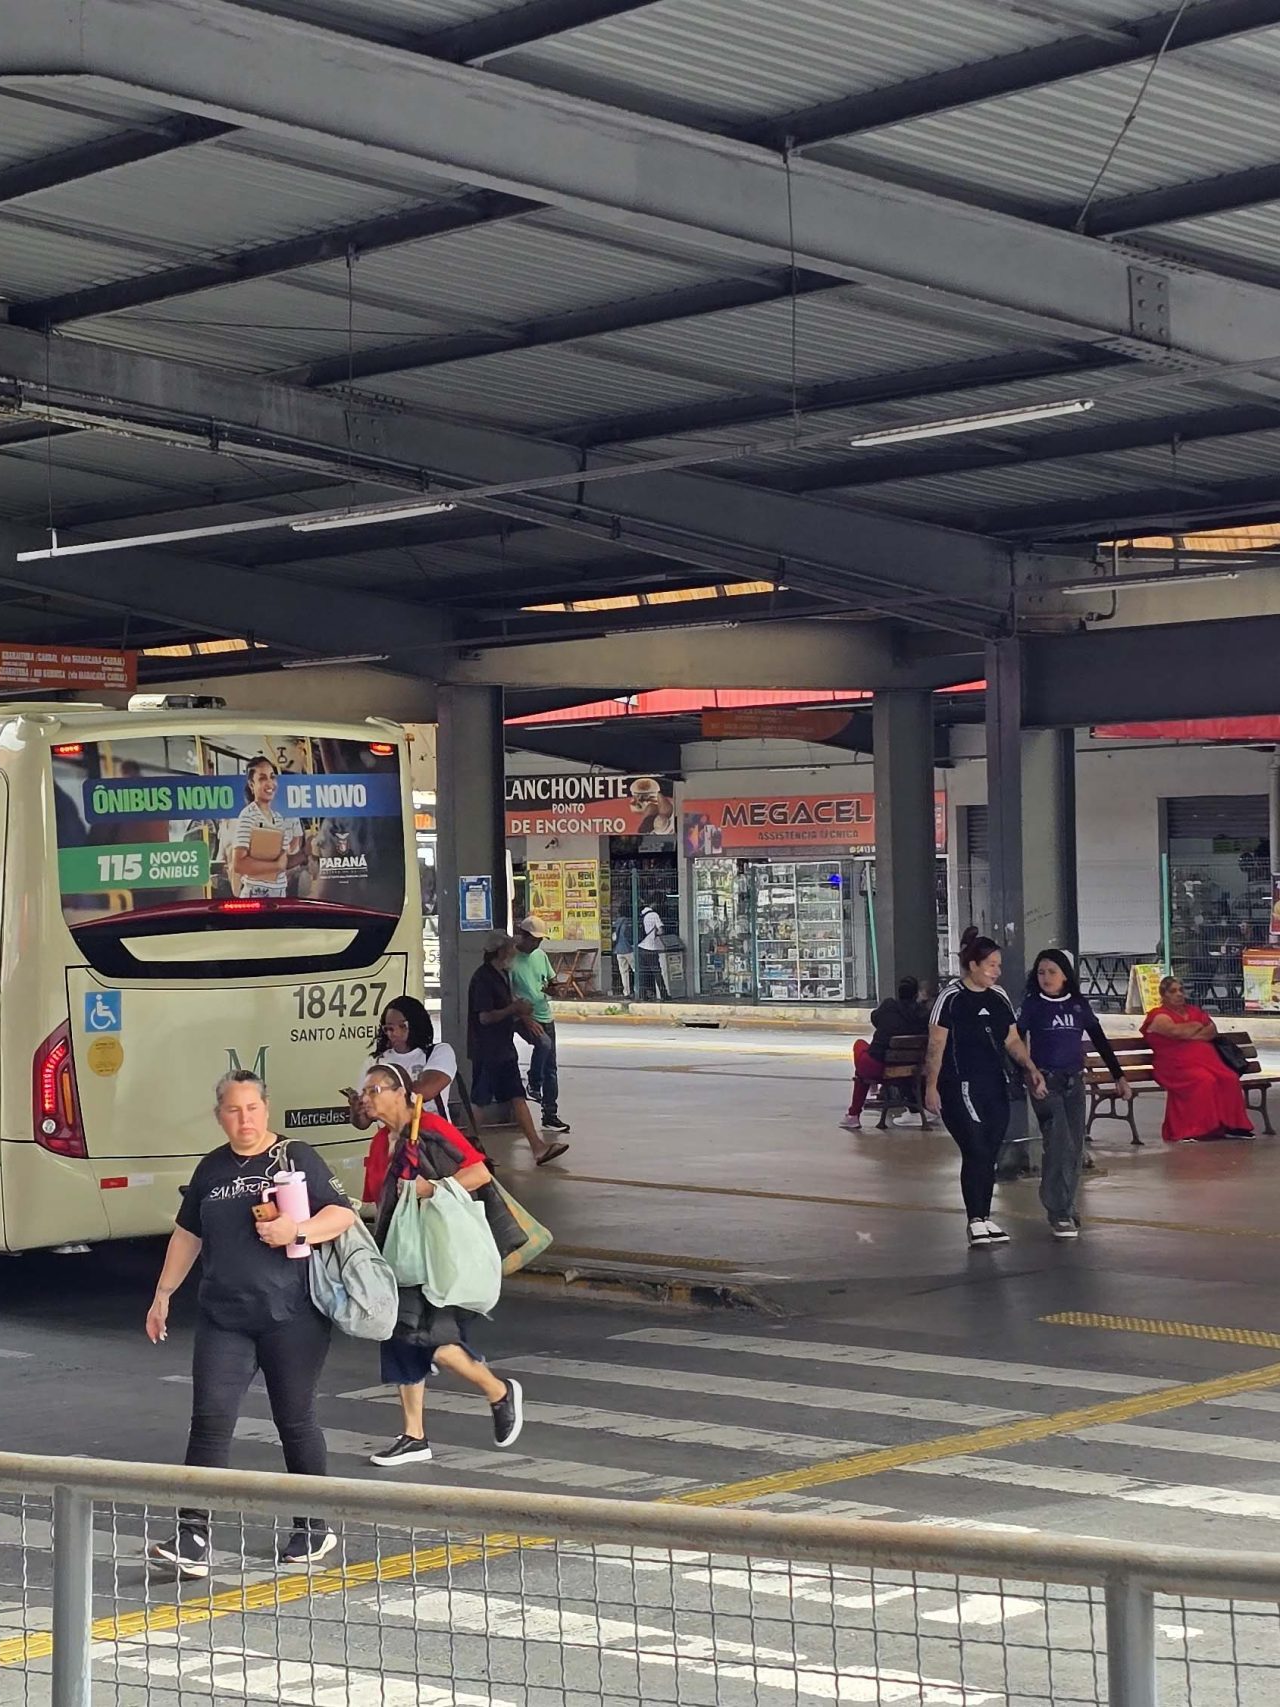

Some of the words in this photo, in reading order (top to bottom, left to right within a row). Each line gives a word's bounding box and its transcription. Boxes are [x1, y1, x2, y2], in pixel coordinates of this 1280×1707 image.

[505, 776, 628, 800] LANCHONETE
[92, 785, 173, 814] ÔNIBUS
[176, 785, 234, 811] NOVO
[286, 784, 313, 809] DE
[315, 784, 367, 809] NOVO
[551, 802, 586, 815] PONTO
[720, 799, 874, 828] MEGACEL
[510, 819, 531, 834] DE
[535, 817, 626, 834] ENCONTRO
[149, 851, 198, 865] NOVOS
[319, 854, 368, 868] PARANÁ
[97, 853, 143, 882] 115
[149, 864, 200, 880] ÔNIBUS
[293, 982, 388, 1020] 18427
[290, 1027, 335, 1042] SANTO
